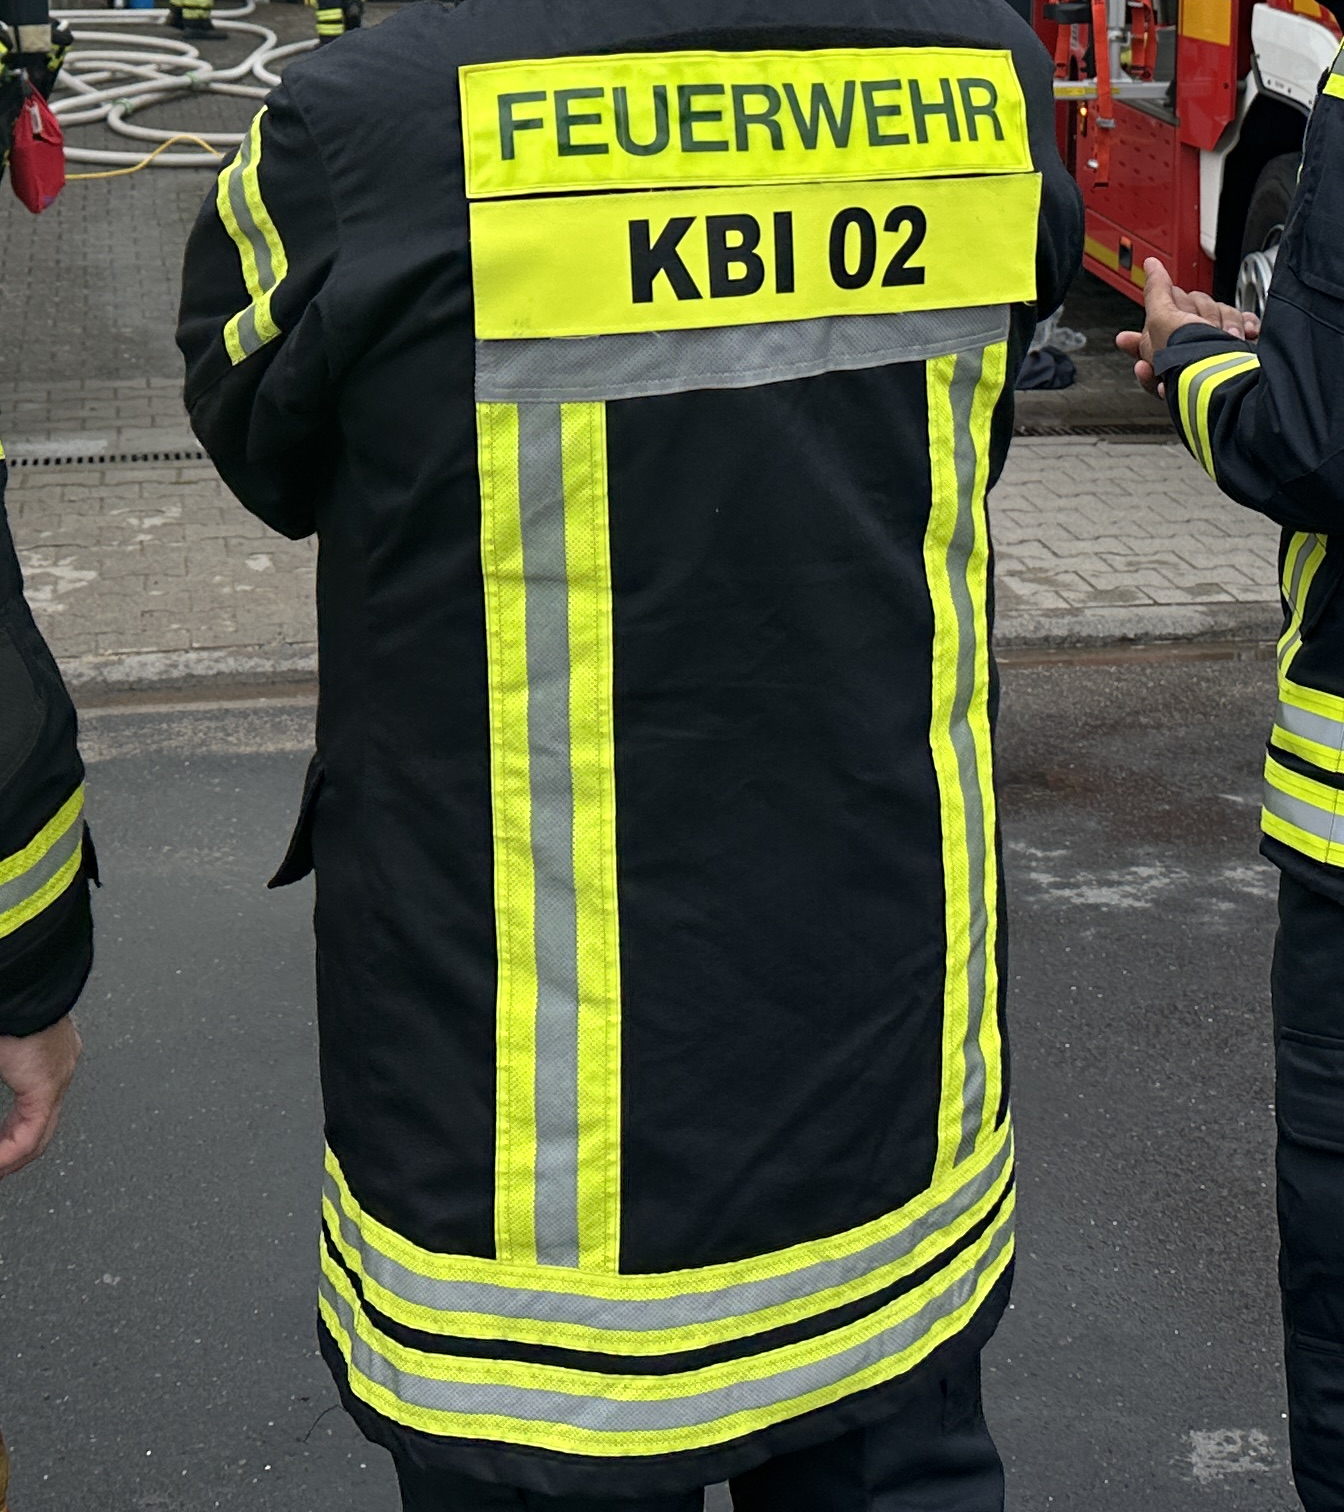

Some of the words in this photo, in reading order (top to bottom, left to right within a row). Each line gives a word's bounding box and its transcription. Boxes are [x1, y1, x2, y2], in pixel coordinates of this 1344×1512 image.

[497, 77, 1005, 161] FEUERWEHR
[628, 210, 796, 304] KBI
[829, 204, 927, 291] 02
